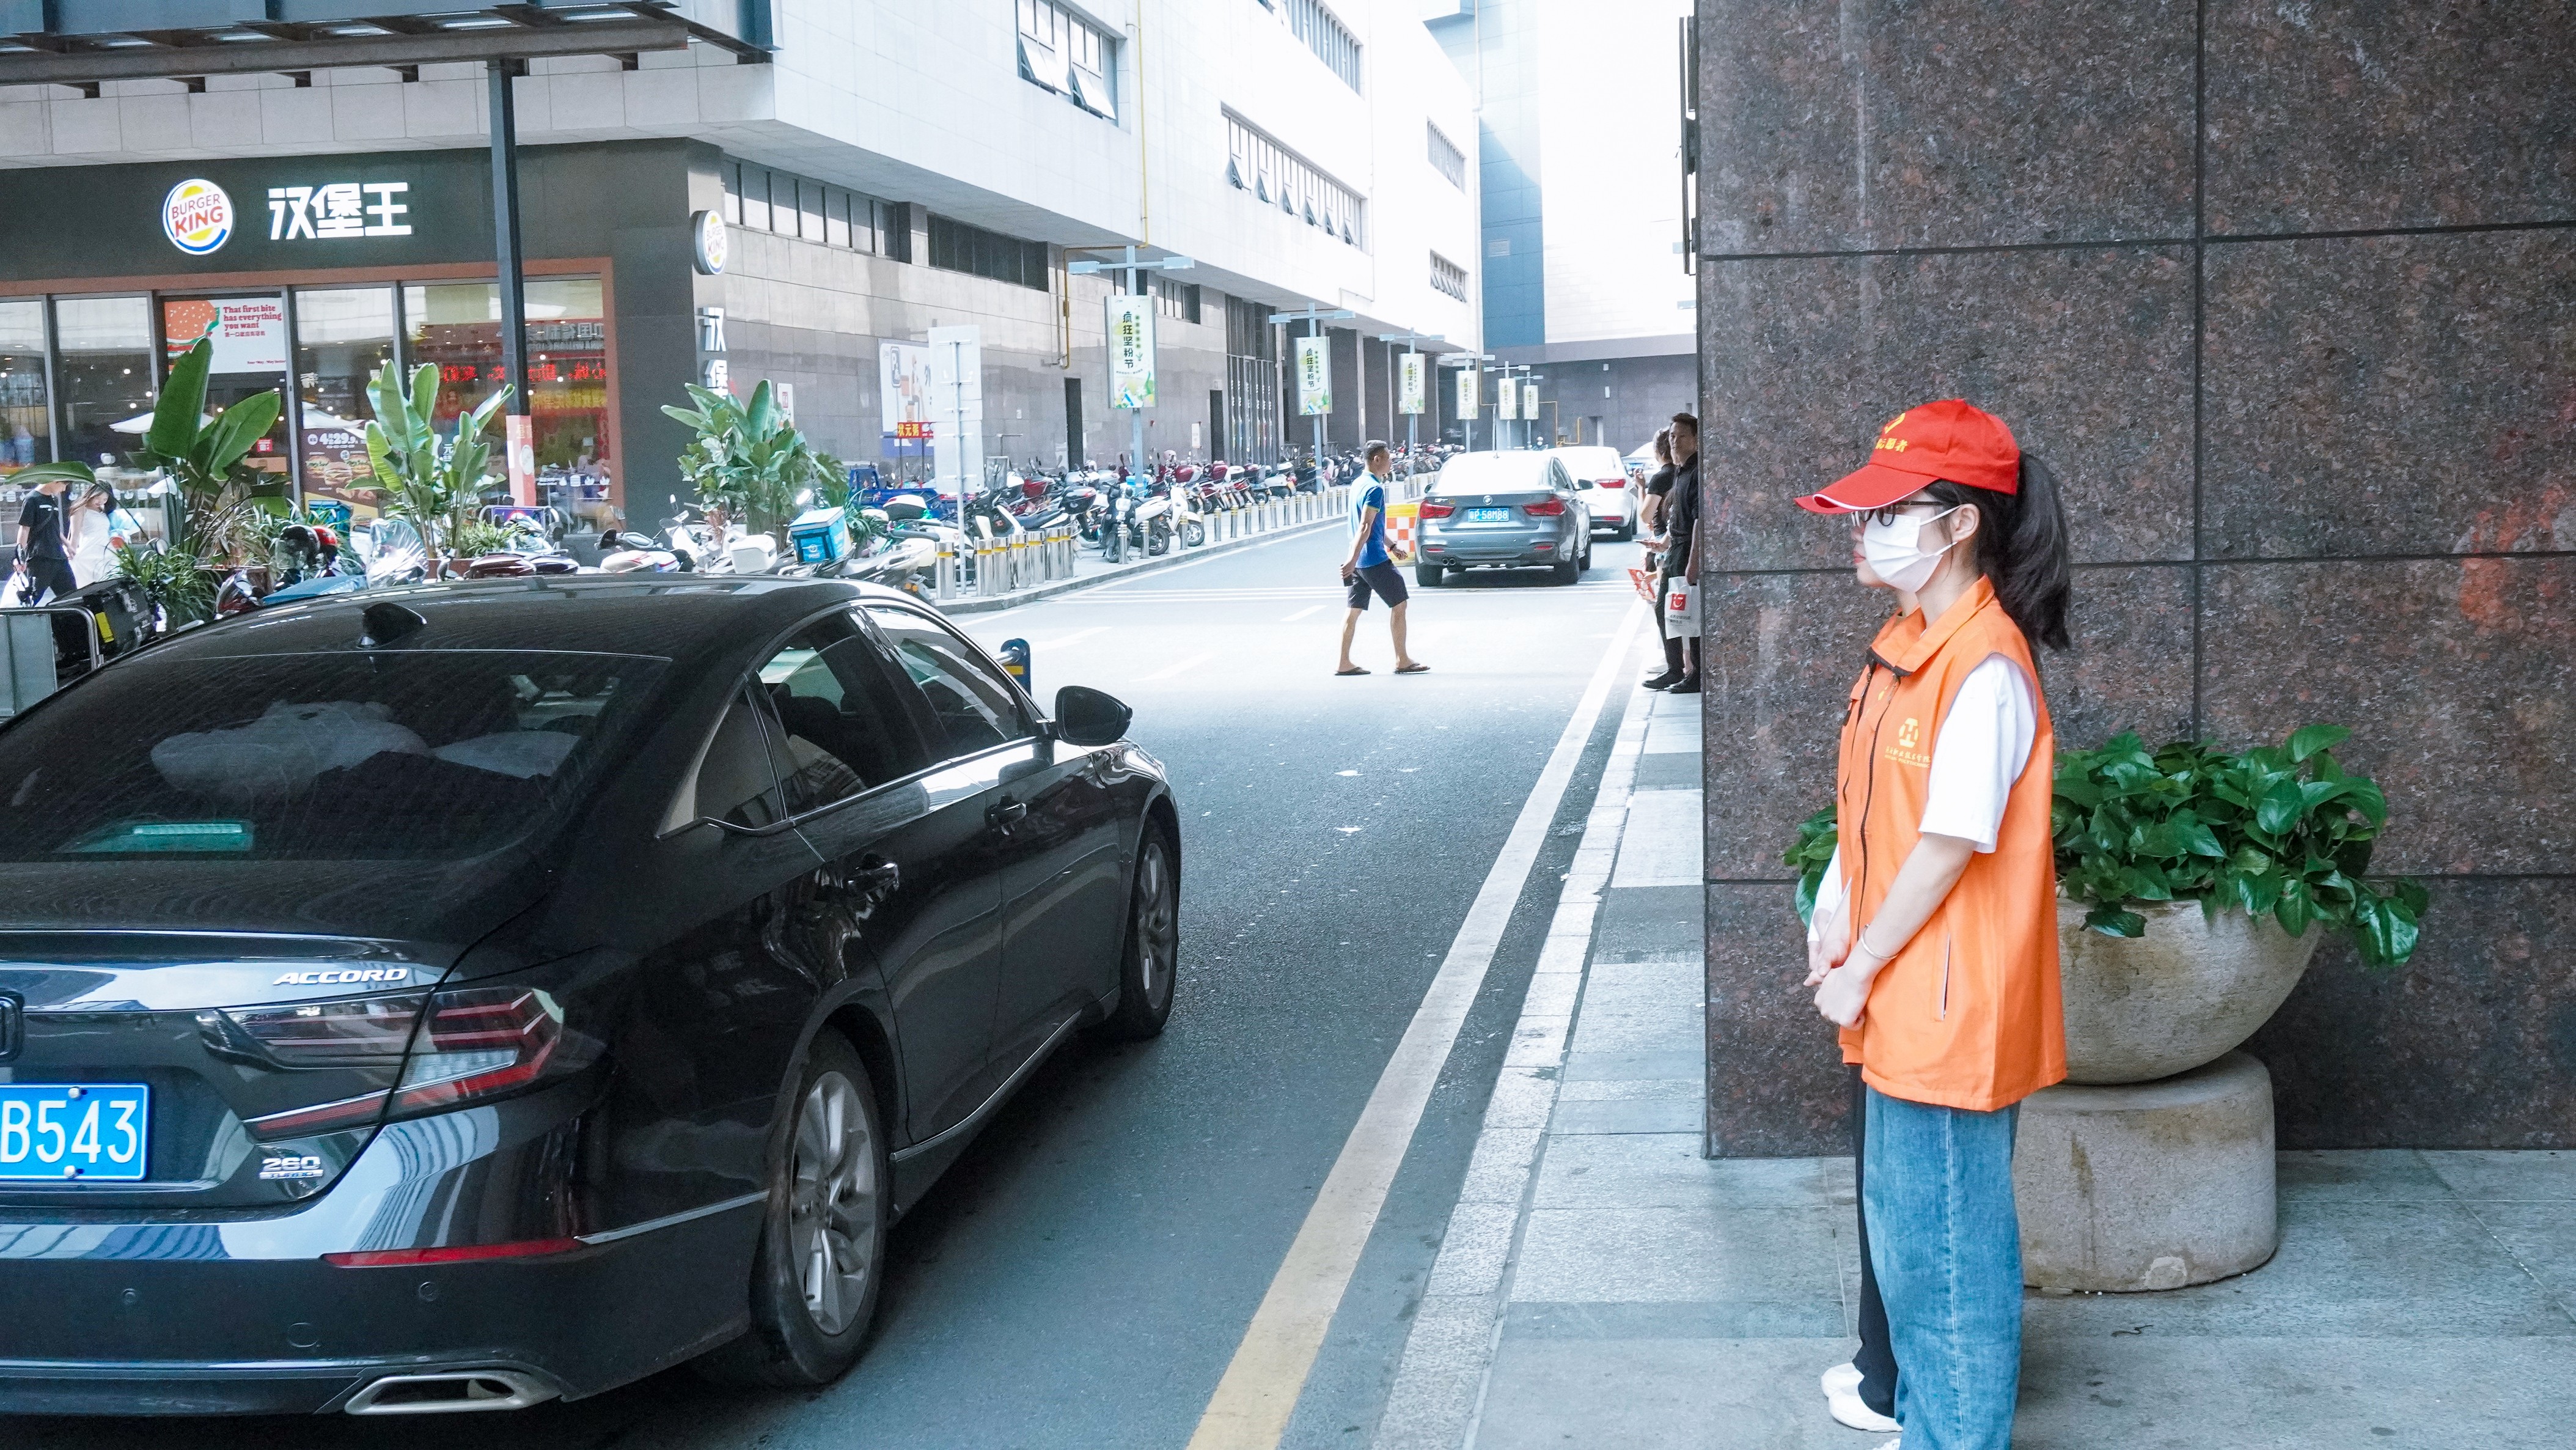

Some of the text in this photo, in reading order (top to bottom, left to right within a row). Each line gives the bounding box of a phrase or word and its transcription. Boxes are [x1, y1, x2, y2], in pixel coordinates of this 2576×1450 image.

[172, 194, 221, 219] BURGER
[268, 182, 413, 240] 汉堡王
[175, 205, 224, 238] KING
[238, 312, 282, 322] everything
[1122, 311, 1134, 369] 疯狂坚粉节
[273, 968, 408, 985] ACCORD
[0, 1100, 138, 1163] B543
[262, 1156, 321, 1171] 260
